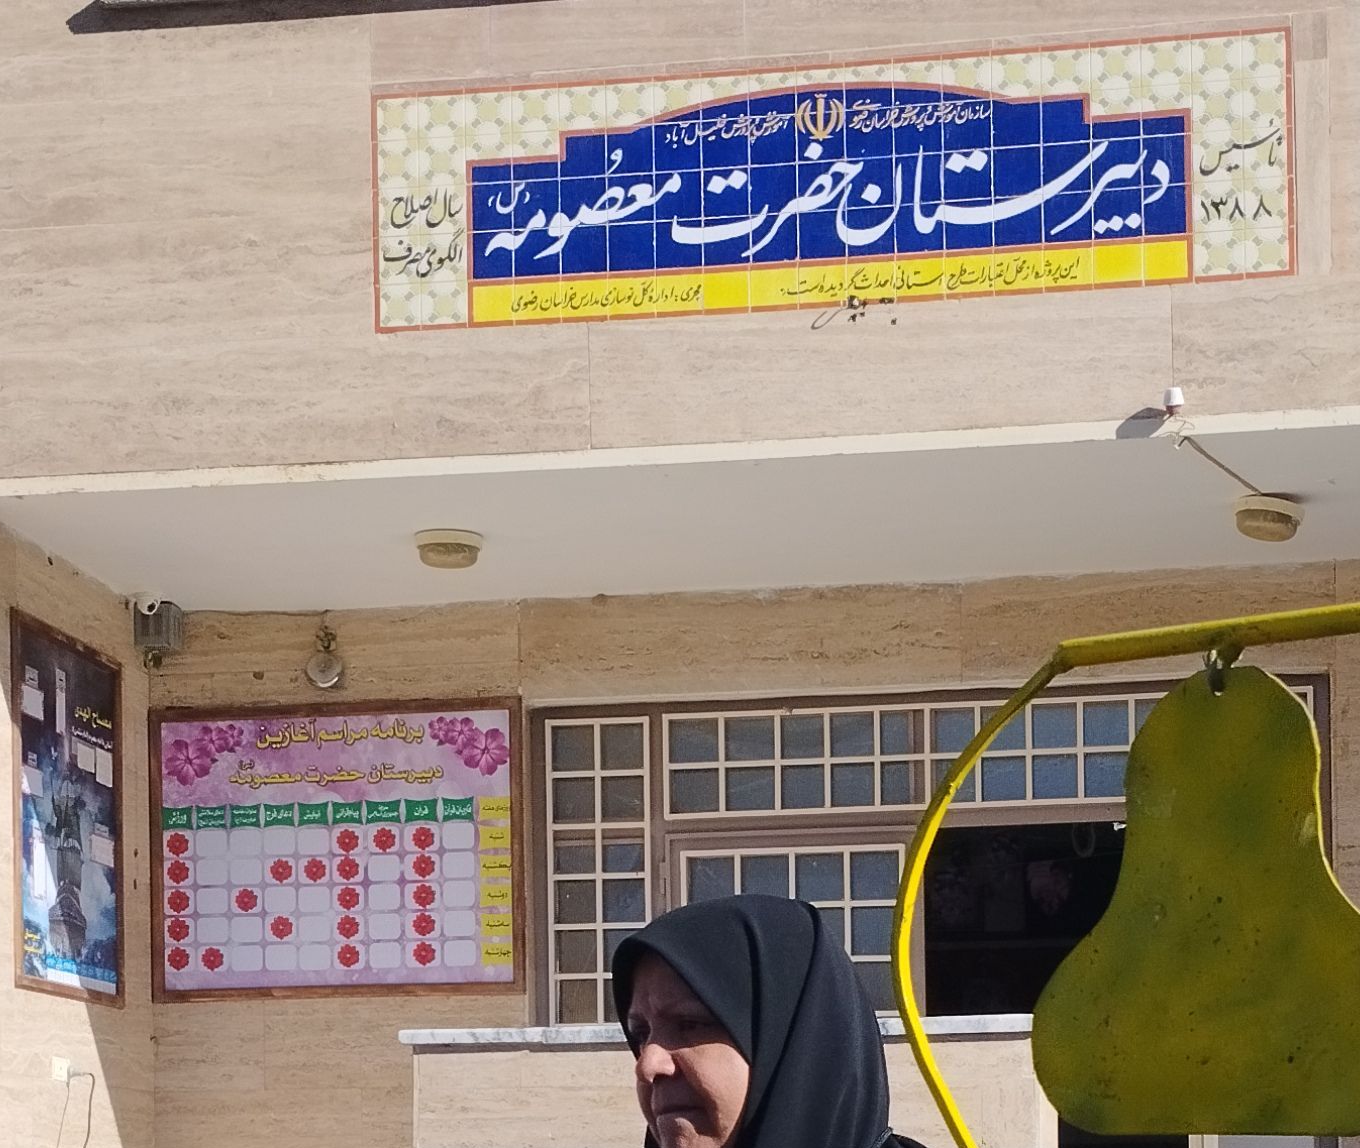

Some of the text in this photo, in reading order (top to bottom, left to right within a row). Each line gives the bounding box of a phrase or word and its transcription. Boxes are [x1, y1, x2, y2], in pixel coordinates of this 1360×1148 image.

[390, 187, 464, 230] سال اصلاح
[670, 143, 865, 259] حضرت
[835, 140, 1171, 246] دبیرستان
[382, 227, 465, 279] الگوی مصرف
[1059, 256, 1080, 280] این
[256, 718, 425, 750] برنامه مراسم آغازین
[229, 770, 303, 790] معصومه
[304, 765, 366, 786] حضرت
[367, 763, 444, 784] دبیرستان
